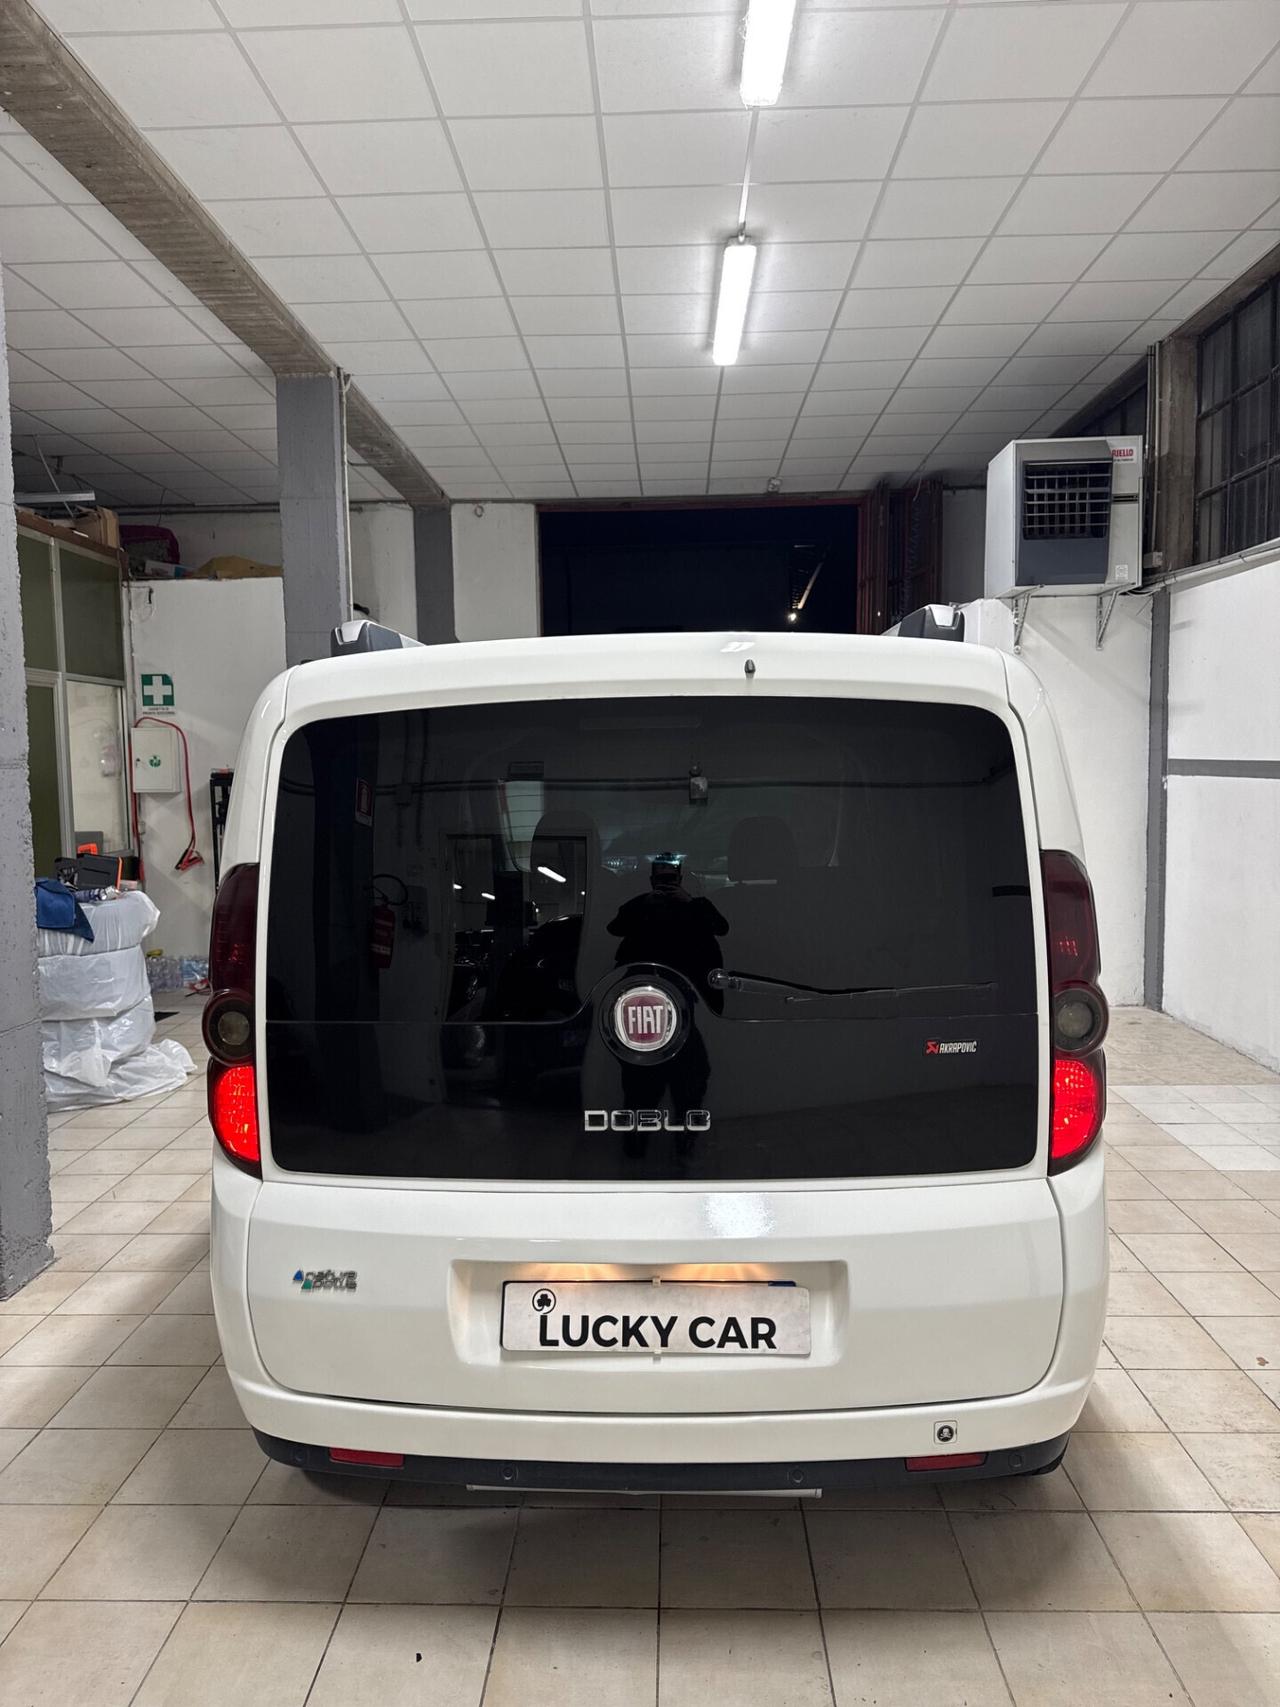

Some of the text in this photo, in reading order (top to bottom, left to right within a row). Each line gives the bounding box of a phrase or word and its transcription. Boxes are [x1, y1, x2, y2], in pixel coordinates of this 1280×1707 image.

[627, 1005, 664, 1035] FIAT
[584, 1109, 711, 1132] DOBLO
[539, 1314, 777, 1349] LUCKY CAR
